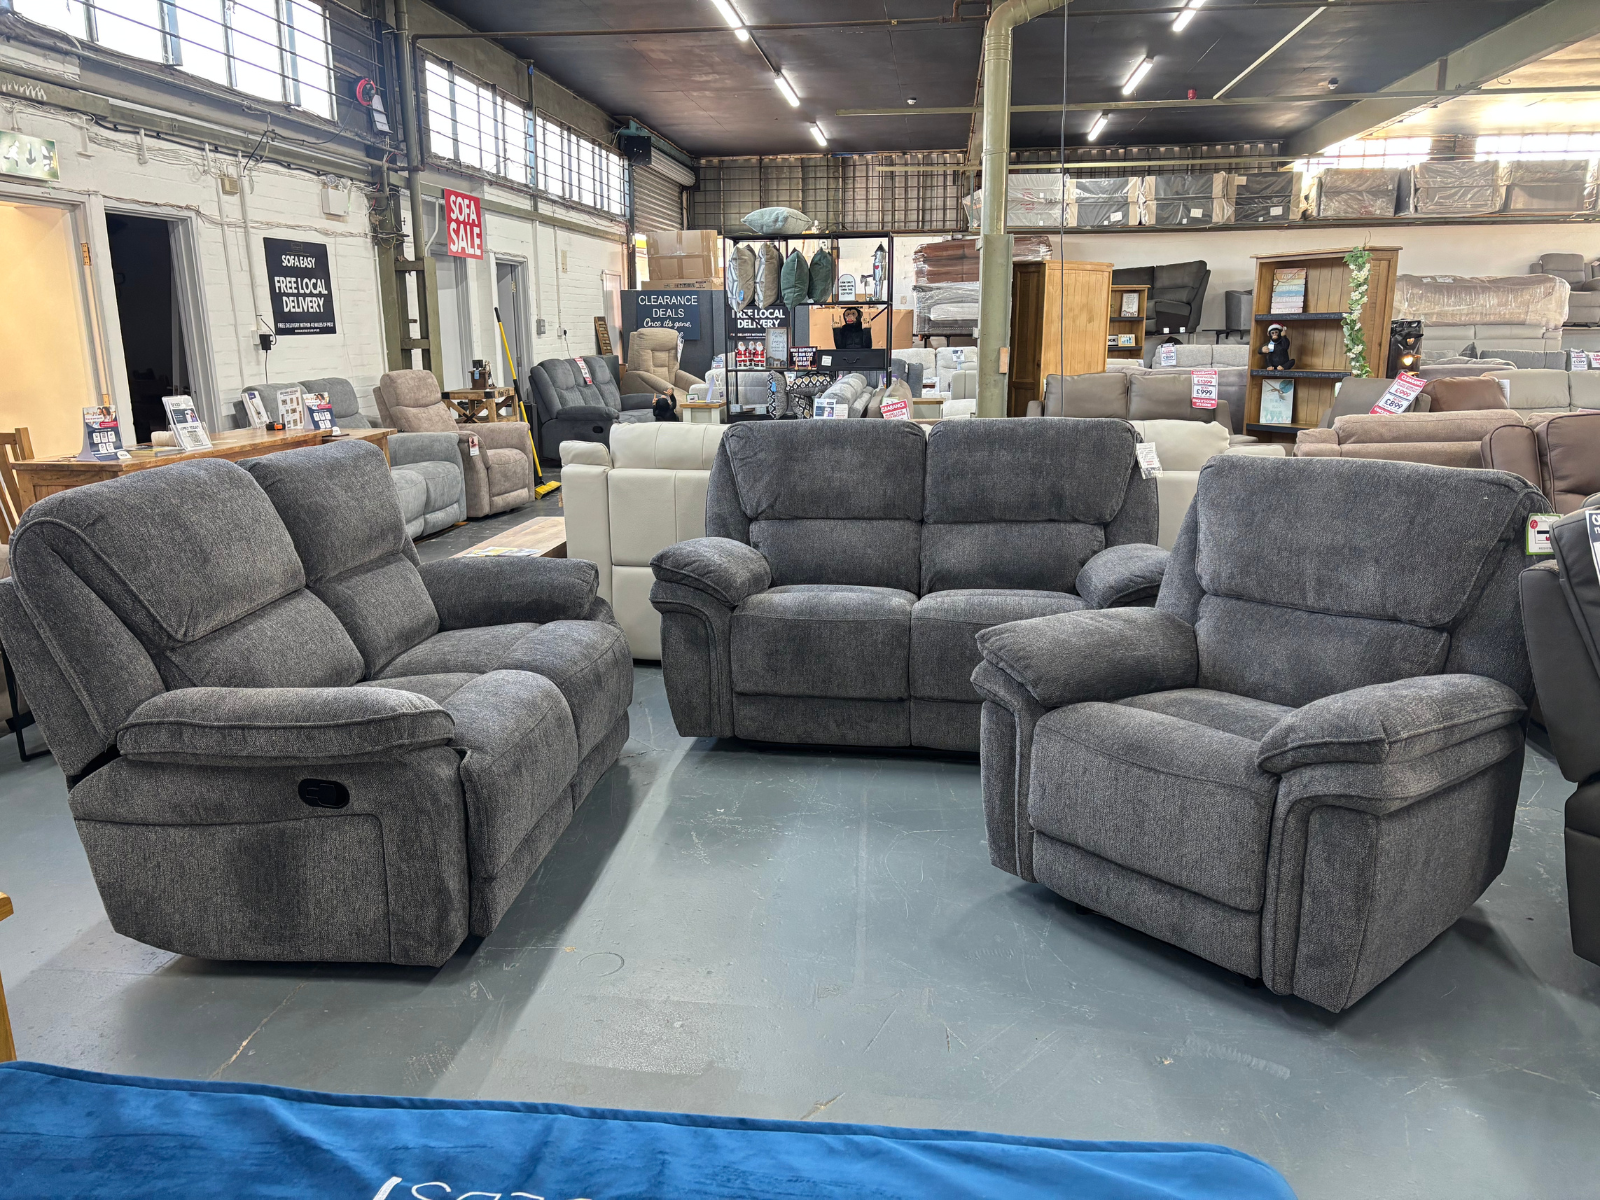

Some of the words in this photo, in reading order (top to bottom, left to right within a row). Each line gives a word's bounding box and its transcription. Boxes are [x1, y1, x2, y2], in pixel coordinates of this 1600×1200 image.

[450, 194, 478, 224] SOFA
[449, 221, 481, 256] SALE
[282, 255, 300, 268] SOFA
[300, 256, 316, 269] EASY
[274, 276, 298, 293] FREE
[298, 277, 328, 295] LOCAL
[282, 296, 325, 312] DELIVERY
[638, 295, 698, 305] CLEARANCE
[652, 308, 685, 318] DEALS
[754, 309, 785, 318] LOCAL
[643, 318, 661, 328] Once
[737, 319, 780, 328] DELIVERY
[1196, 388, 1213, 396] £999
[1394, 387, 1412, 398] £999
[1384, 398, 1404, 410] £899
